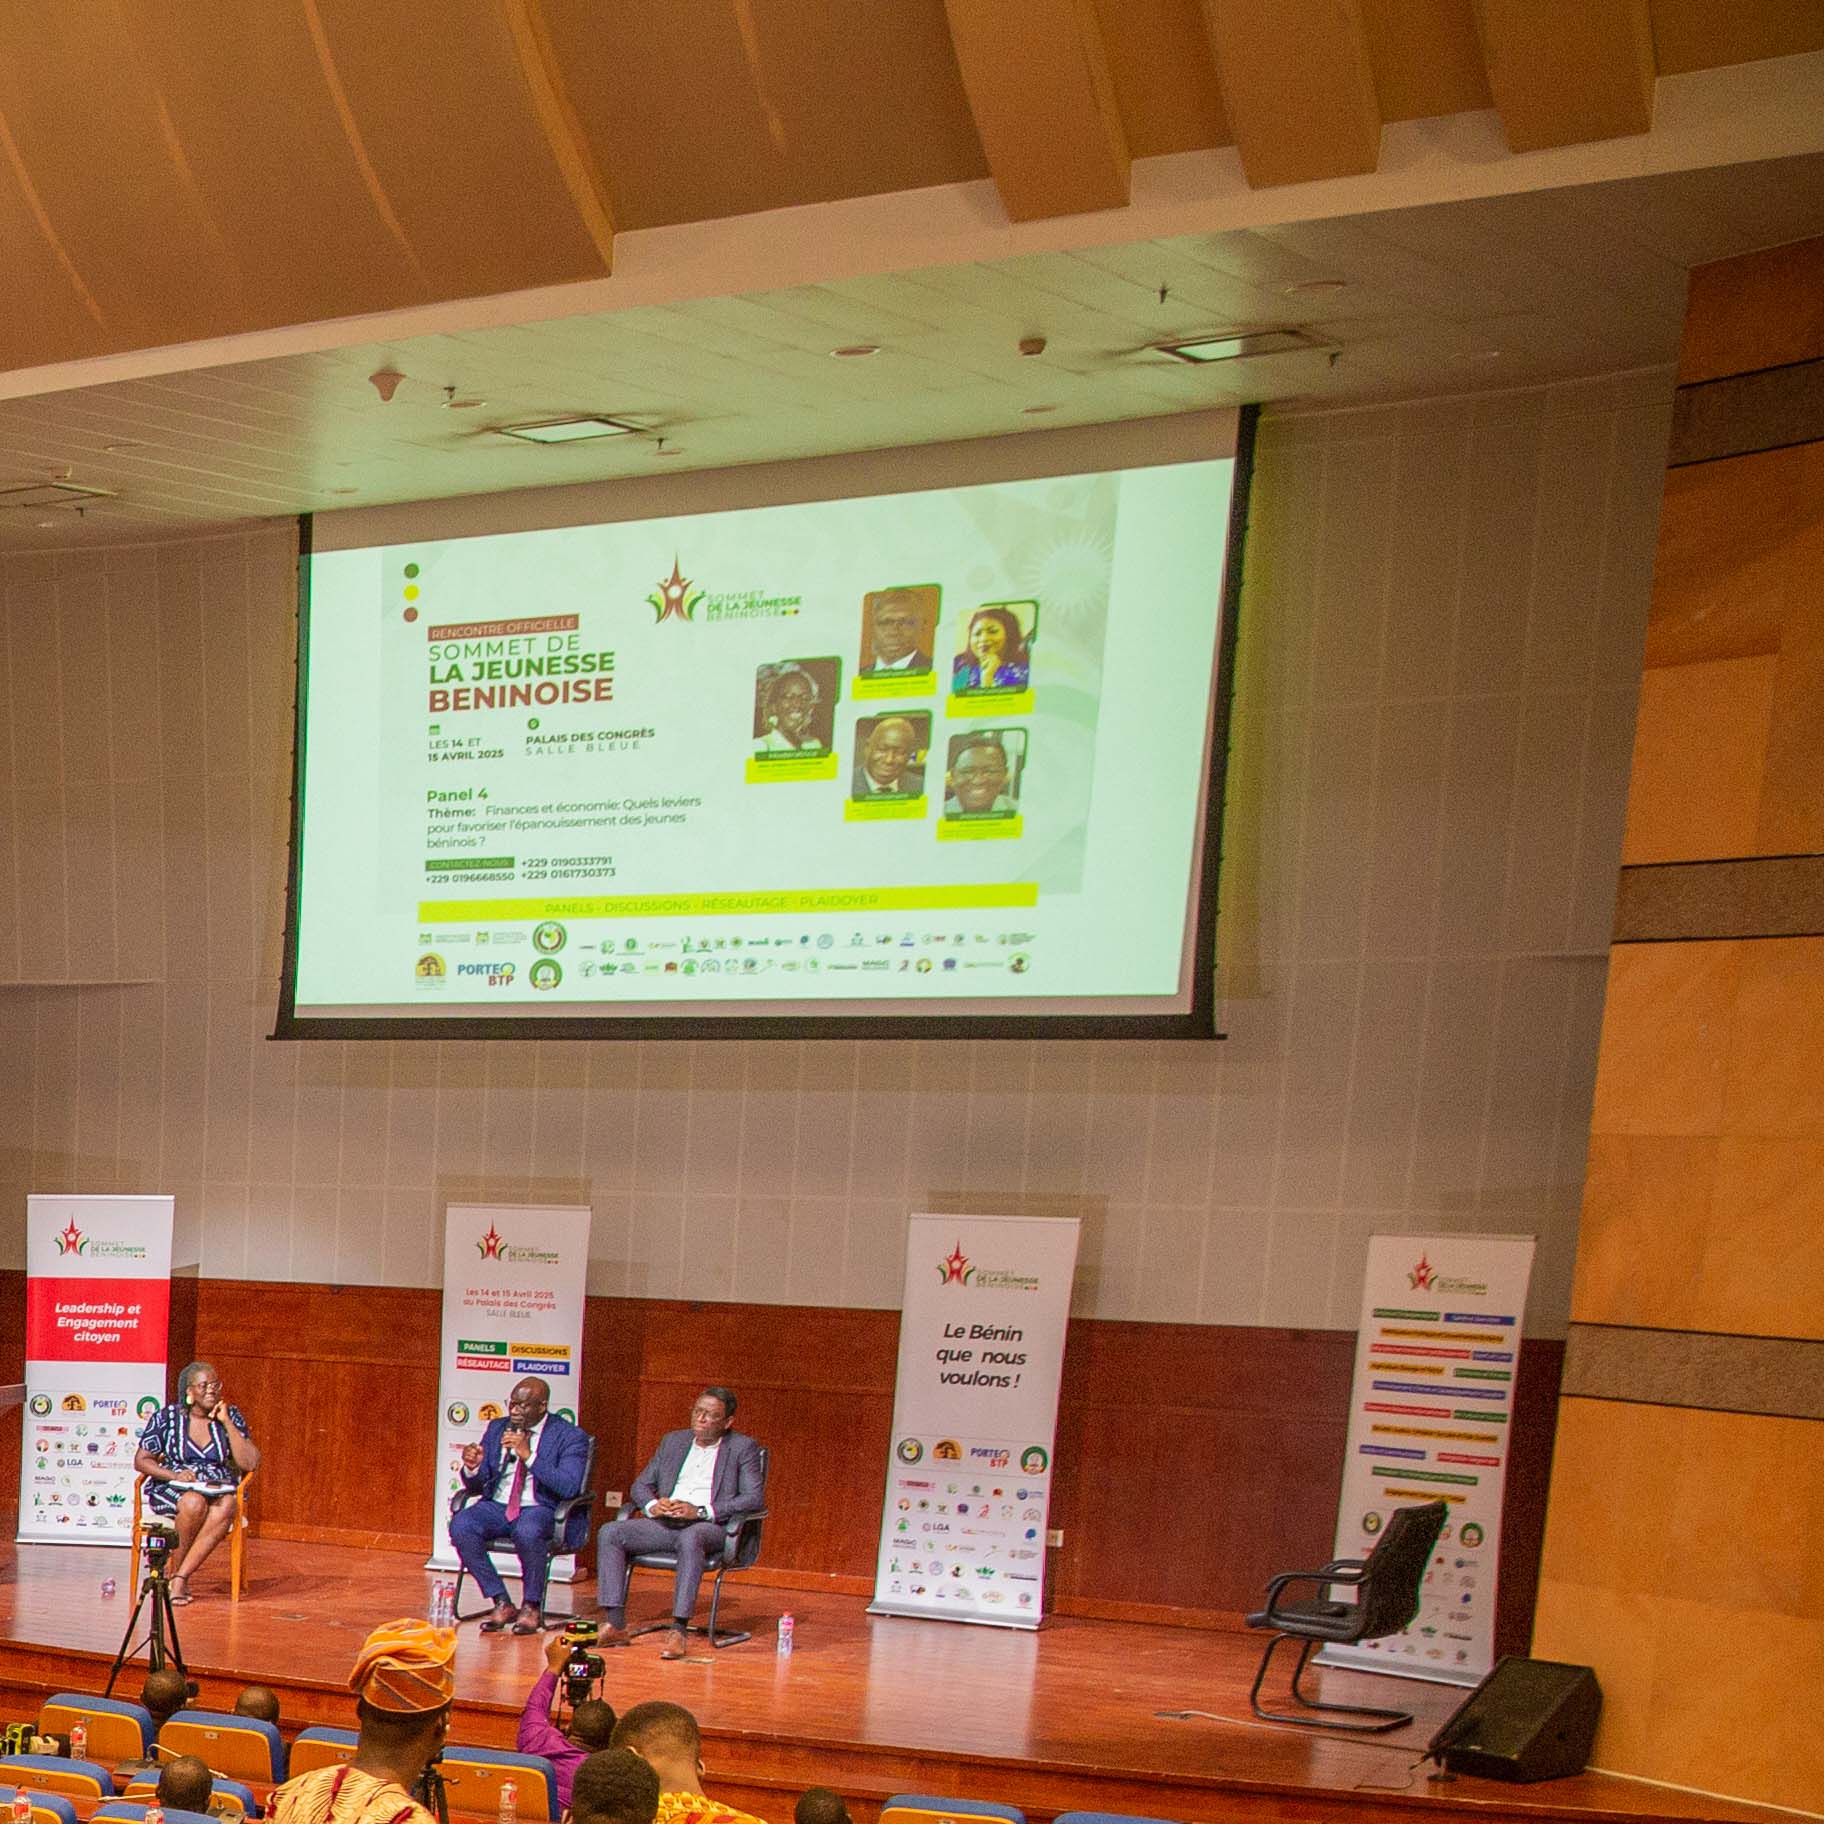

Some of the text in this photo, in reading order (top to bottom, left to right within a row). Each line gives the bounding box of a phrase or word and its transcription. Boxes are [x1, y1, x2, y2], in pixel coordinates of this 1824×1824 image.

[743, 596, 801, 609] JEUNESSE
[431, 616, 576, 640] RENCONTRE OFFICIELLE
[429, 634, 581, 662] SOMMET DE
[430, 652, 615, 684] LA JEUNESSE
[429, 678, 614, 712] BENINOISE
[526, 728, 655, 745] PALAIS DES CONGRÈS
[429, 737, 481, 750] LES 14 ET
[525, 741, 641, 757] SALLE BLEUE
[428, 749, 504, 762] 15 AVRIL 2025
[427, 787, 489, 803] Panel 4
[428, 808, 476, 819] Thème:
[485, 804, 539, 817] Finances
[542, 804, 553, 814] et
[623, 797, 659, 811] Quels
[661, 796, 701, 809] leviers
[427, 823, 455, 836] pour
[457, 820, 507, 833] favoriser
[619, 813, 642, 825] des
[644, 812, 686, 826] jeunes
[427, 836, 477, 849] béninois
[521, 857, 548, 868] +229
[426, 874, 449, 883] +229
[521, 870, 548, 880] +229
[545, 903, 593, 913] PANELS
[605, 900, 690, 913] DISCUSSIONS
[488, 975, 514, 986] BTP
[466, 1288, 479, 1296] Les
[502, 1289, 511, 1298] 15
[512, 1289, 532, 1298] Avril
[55, 1303, 141, 1315] Leadership et
[476, 1299, 501, 1308] Palais
[504, 1299, 518, 1308] des
[57, 1317, 138, 1329] Engagement
[74, 1331, 120, 1344] citoyen
[944, 1323, 1022, 1341] Le Bénin
[463, 1342, 568, 1356] PANELS DISCUSSIONS
[936, 1348, 1027, 1365] que nous
[517, 1362, 566, 1372] PLAIDOYER
[940, 1370, 1021, 1389] voulons !
[111, 1408, 127, 1416] BTP
